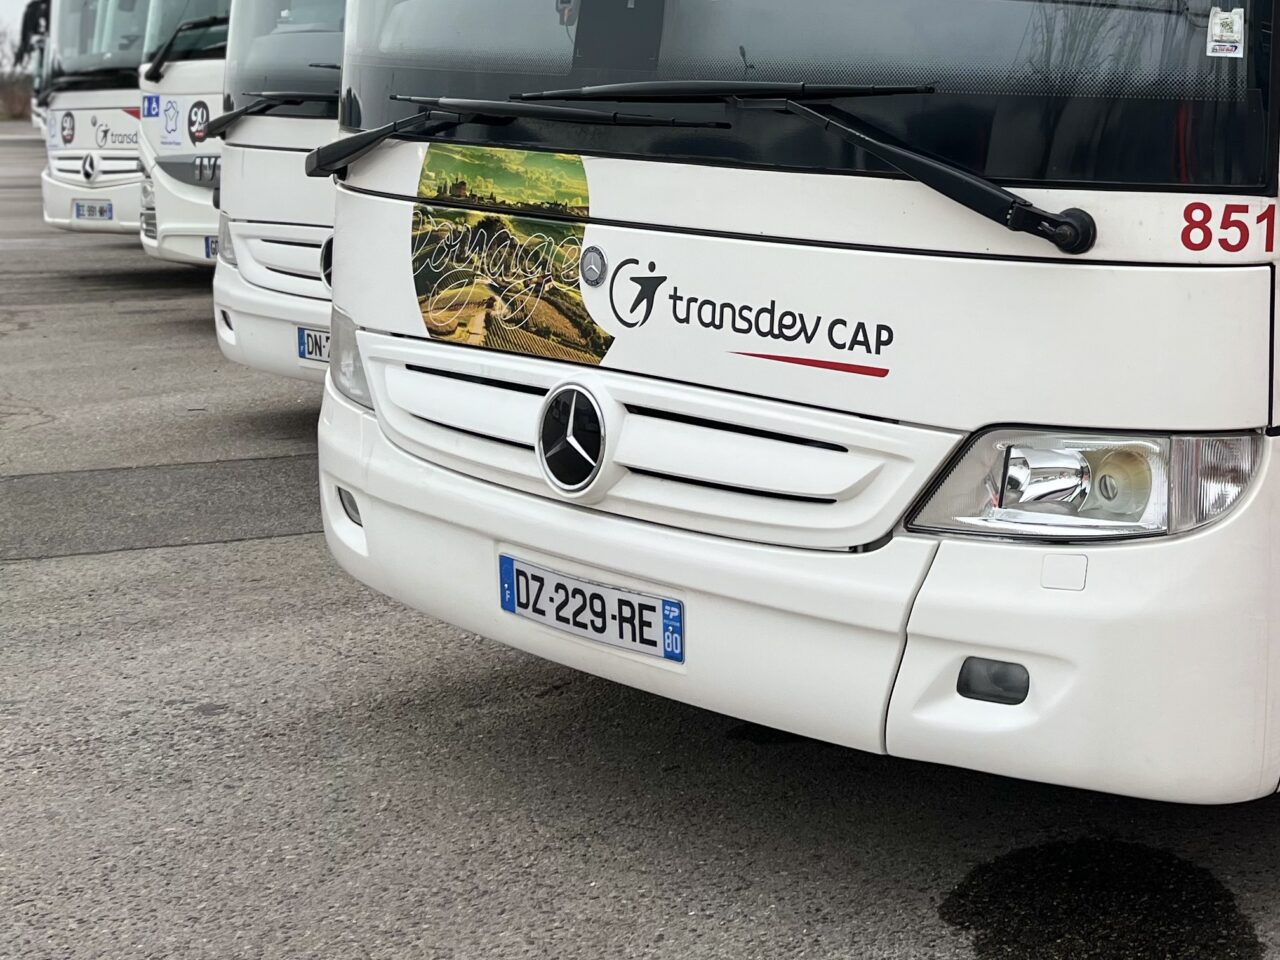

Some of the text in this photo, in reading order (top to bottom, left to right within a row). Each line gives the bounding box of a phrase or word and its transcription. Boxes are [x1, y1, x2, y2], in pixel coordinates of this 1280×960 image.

[1181, 202, 1276, 253] 851
[668, 286, 894, 355] transdev CAP
[515, 568, 658, 648] DZ-229-RE
[664, 631, 681, 654] 80
